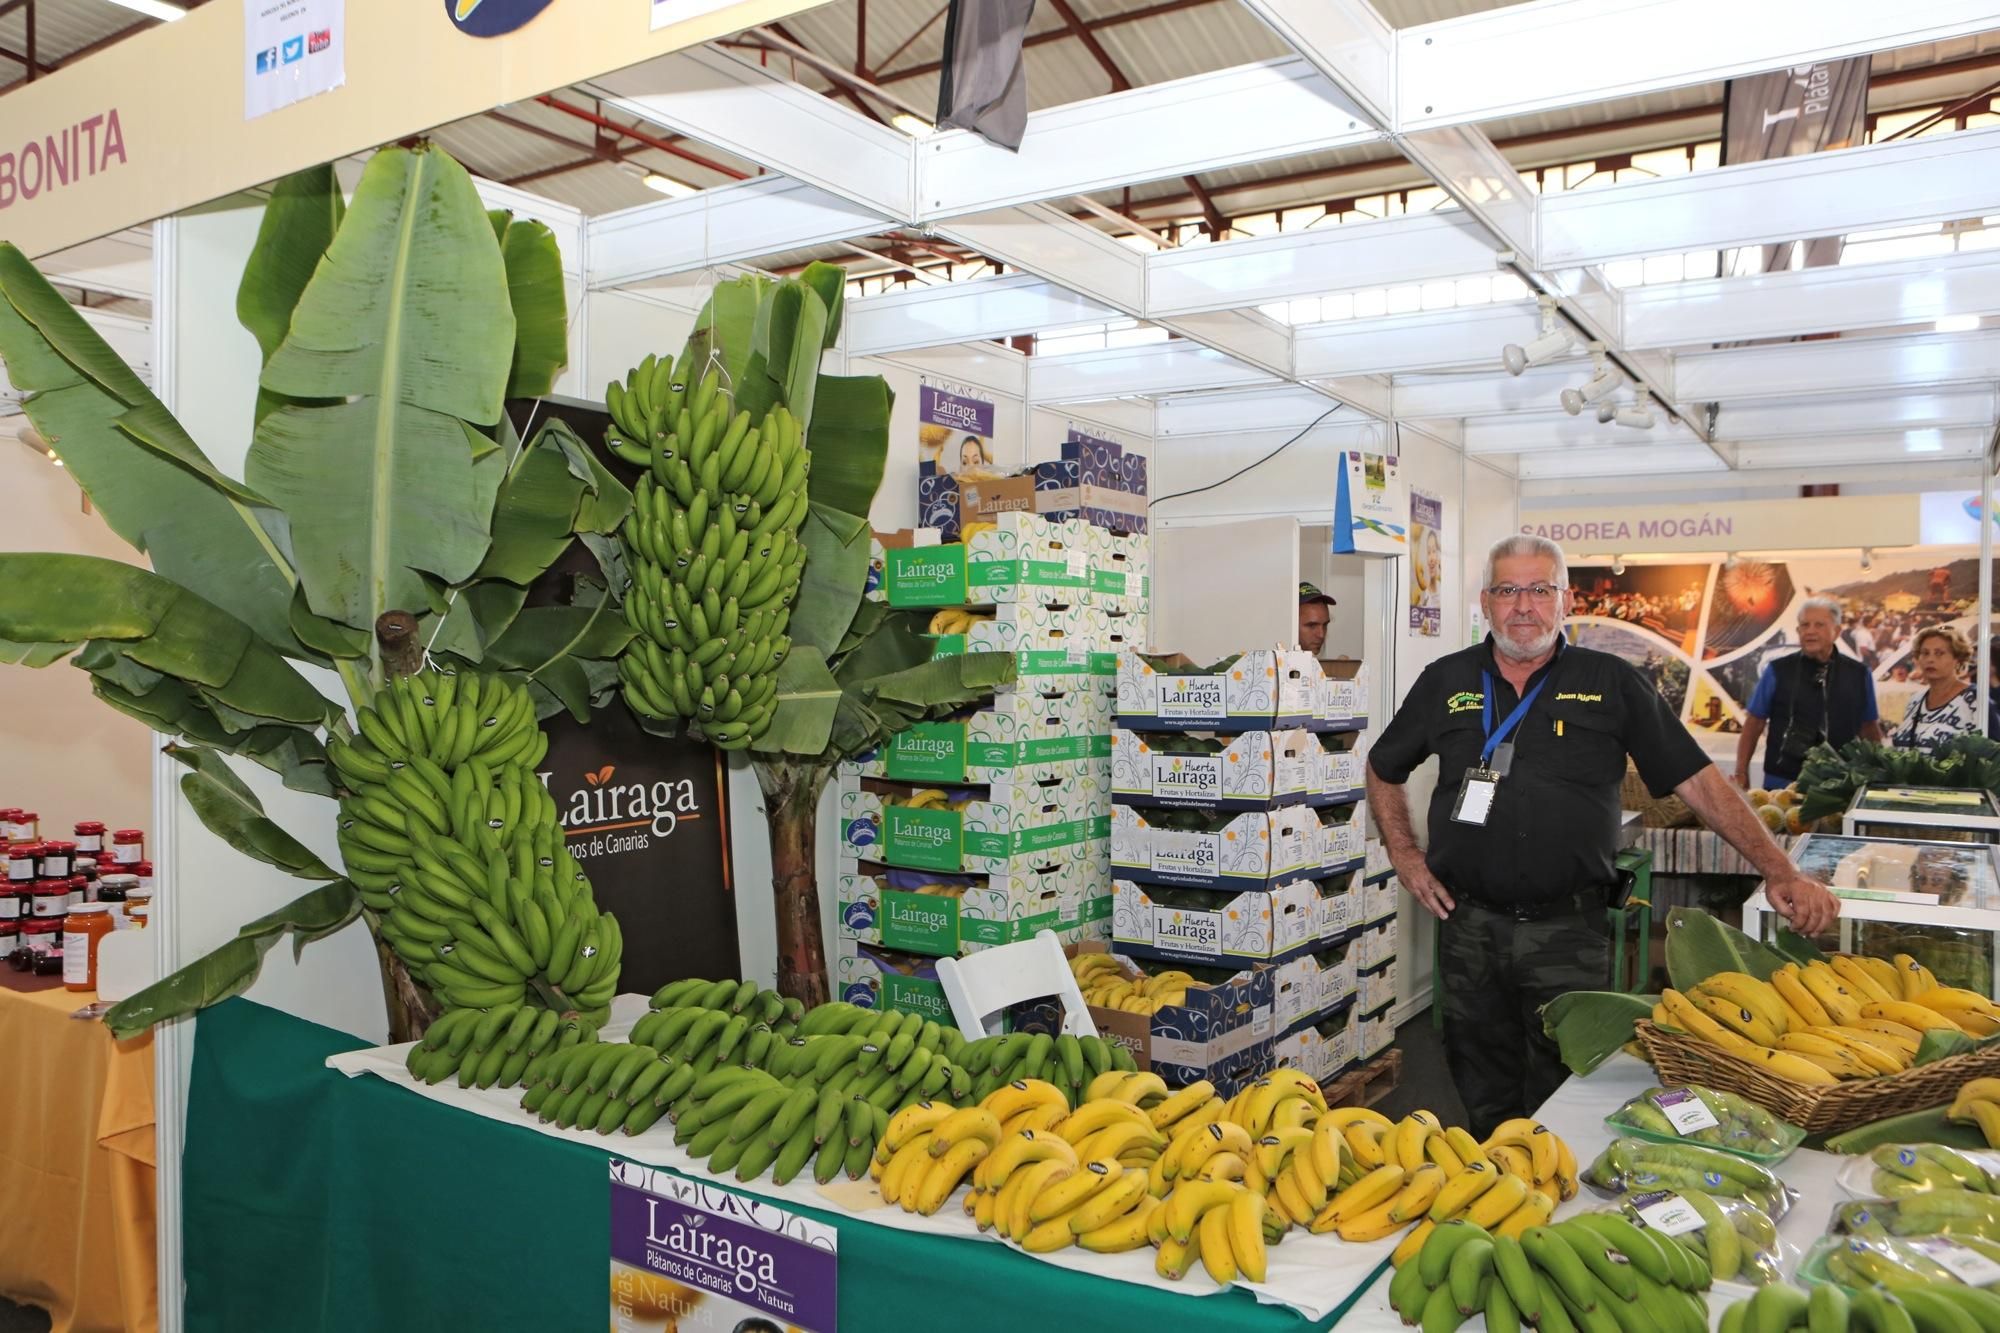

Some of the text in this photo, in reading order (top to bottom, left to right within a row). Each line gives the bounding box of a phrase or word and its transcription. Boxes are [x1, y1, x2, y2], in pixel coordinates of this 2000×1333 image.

[0, 108, 127, 209] BONITA
[933, 391, 977, 427] Lairaga
[977, 497, 1029, 513] Lairaga
[1520, 512, 1733, 541] SABOREA MOGÁN
[897, 559, 955, 583] Lairaga
[1189, 678, 1219, 690] Huerta
[1556, 692, 1576, 700] Juan
[1162, 687, 1220, 708] Lairaga
[1327, 691, 1352, 710] Lairaga
[897, 733, 955, 759] Lairaga
[1157, 767, 1216, 790] Lairaga
[1185, 759, 1216, 772] Huerta
[1160, 788, 1179, 796] Frutas
[590, 836, 603, 856] de
[606, 830, 649, 854] Canarias
[894, 816, 952, 847] Lairaga
[1183, 865, 1214, 874] Hortalizas
[891, 901, 948, 932] Lairaga
[1185, 913, 1216, 927] Huerta
[1158, 918, 1216, 944] Lairaga
[1161, 940, 1179, 948] Frutas
[1185, 943, 1216, 952] Hortalizas
[894, 984, 949, 1016] Lairaga
[646, 1199, 777, 1293] Lairaga
[647, 1250, 732, 1294] Plátanos de Canarias
[613, 1271, 633, 1333] narias
[639, 1275, 713, 1326] Natura
[757, 1288, 794, 1314] Natura
